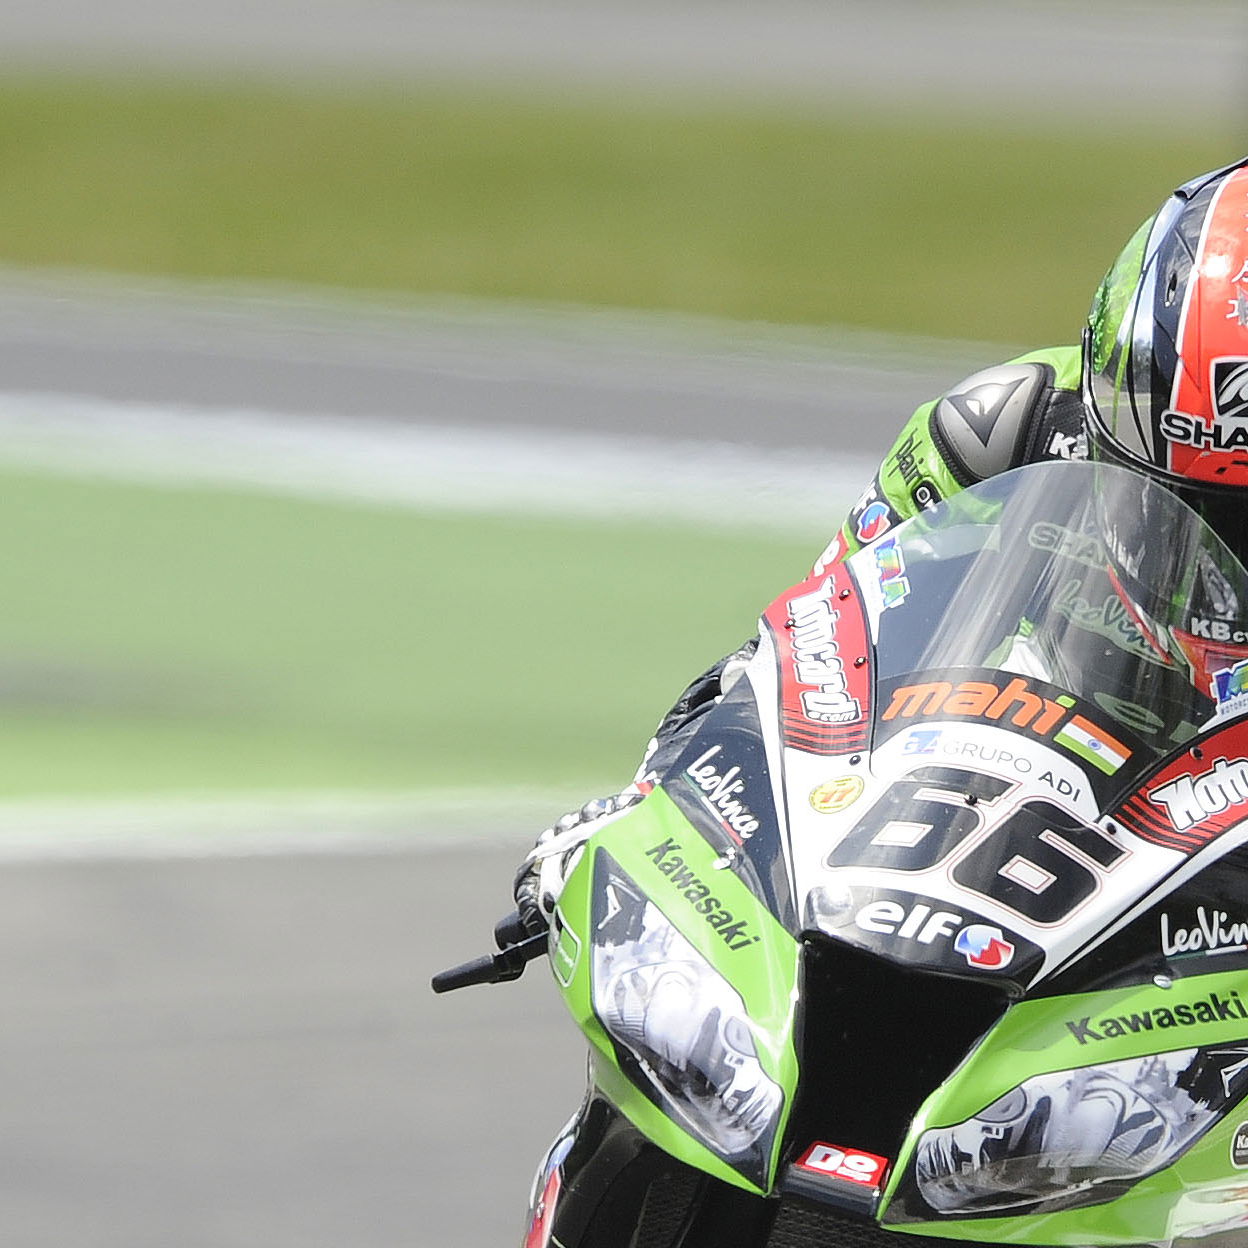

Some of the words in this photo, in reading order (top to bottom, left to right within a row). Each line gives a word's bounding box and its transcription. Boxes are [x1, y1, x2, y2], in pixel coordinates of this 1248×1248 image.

[1191, 617, 1231, 642] KB
[881, 678, 1077, 736] mahi
[686, 745, 760, 839] LeoVince
[944, 741, 1032, 773] GRUPO
[1038, 771, 1081, 802] ADI
[824, 764, 1131, 927] 66
[645, 838, 760, 951] Kawasaki
[855, 901, 963, 944] elf
